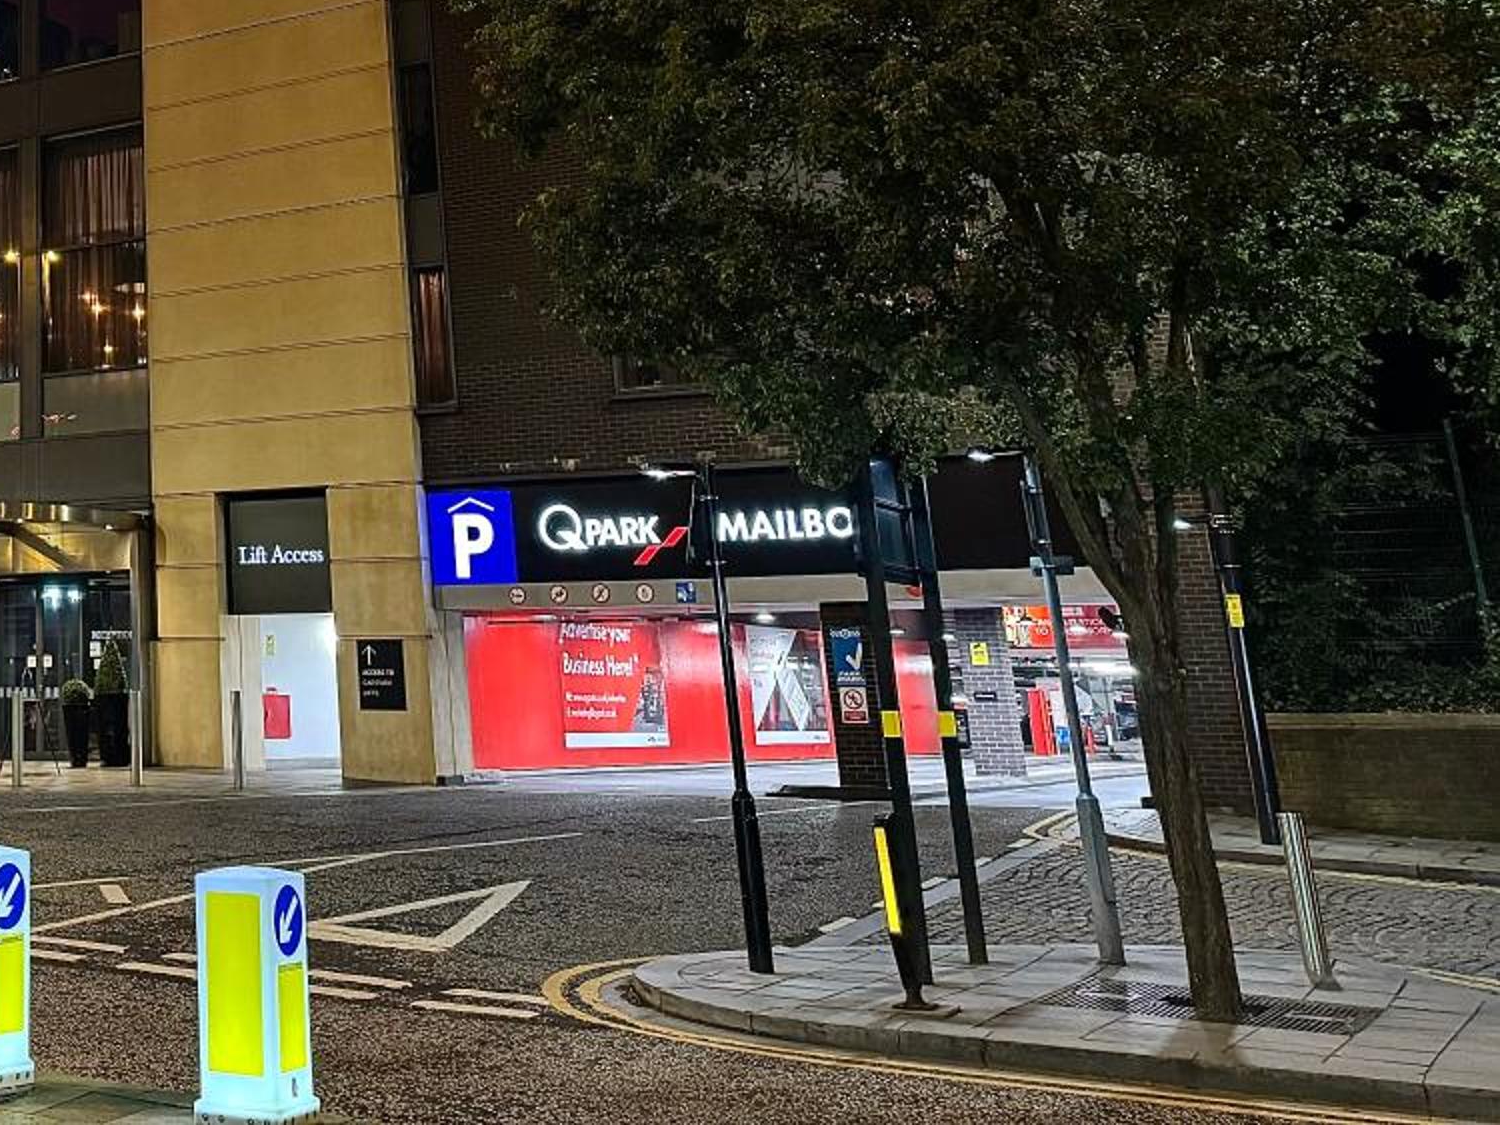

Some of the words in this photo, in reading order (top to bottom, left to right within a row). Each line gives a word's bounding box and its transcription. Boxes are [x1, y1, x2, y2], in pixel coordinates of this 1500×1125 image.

[717, 505, 854, 543] MAILBO
[238, 544, 268, 565] Lift
[270, 543, 325, 565] Access
[451, 512, 496, 580] P
[608, 626, 631, 647] your
[563, 651, 605, 676] Business
